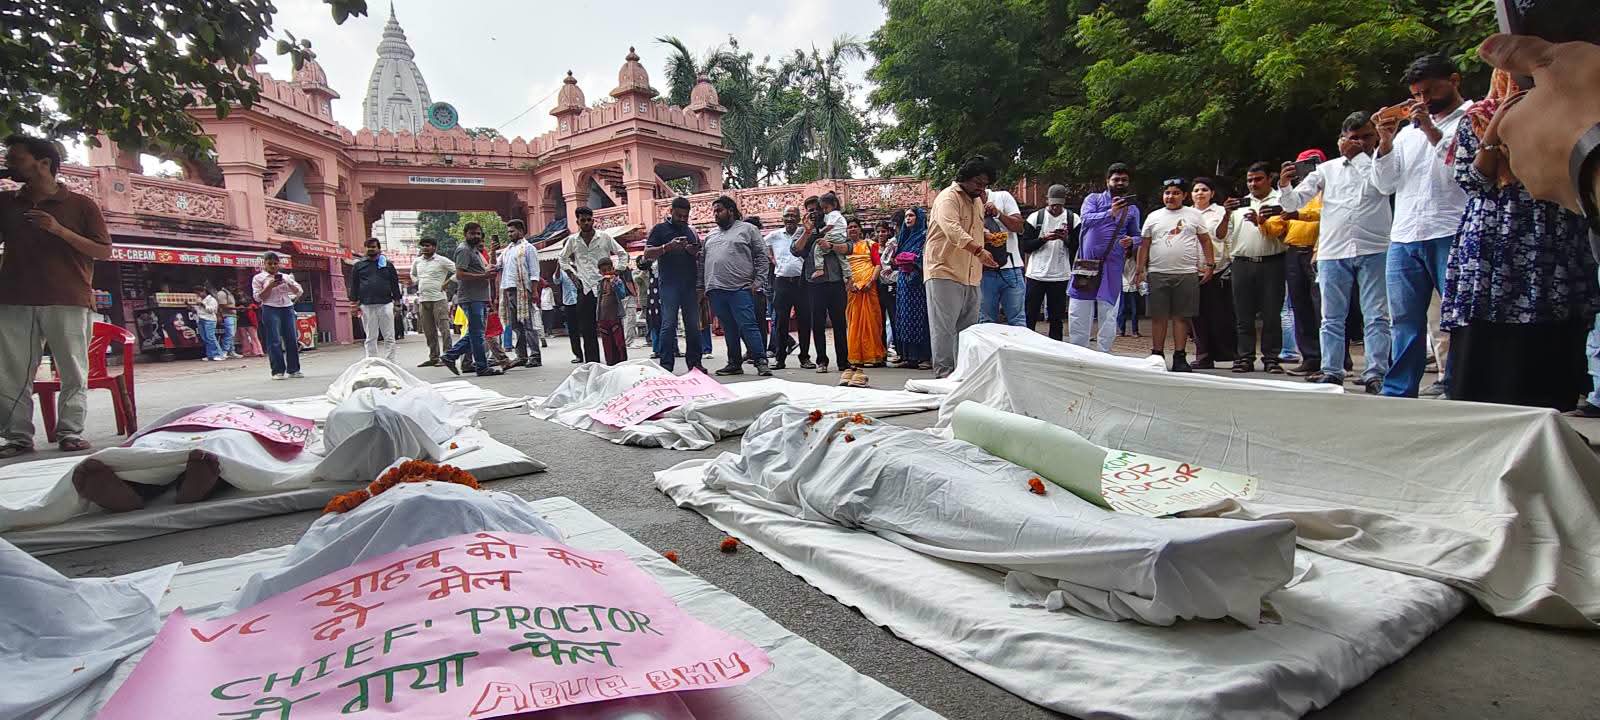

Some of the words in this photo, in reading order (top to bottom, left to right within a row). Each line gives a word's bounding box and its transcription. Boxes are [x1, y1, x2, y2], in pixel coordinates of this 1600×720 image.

[110, 247, 155, 260] CE-CREAM
[191, 613, 271, 642] VC
[466, 533, 528, 561] को
[311, 602, 385, 641] दो
[418, 565, 522, 601] मेल
[455, 604, 664, 636] PROCTOR
[337, 651, 480, 715] गया
[508, 632, 622, 667] फेल
